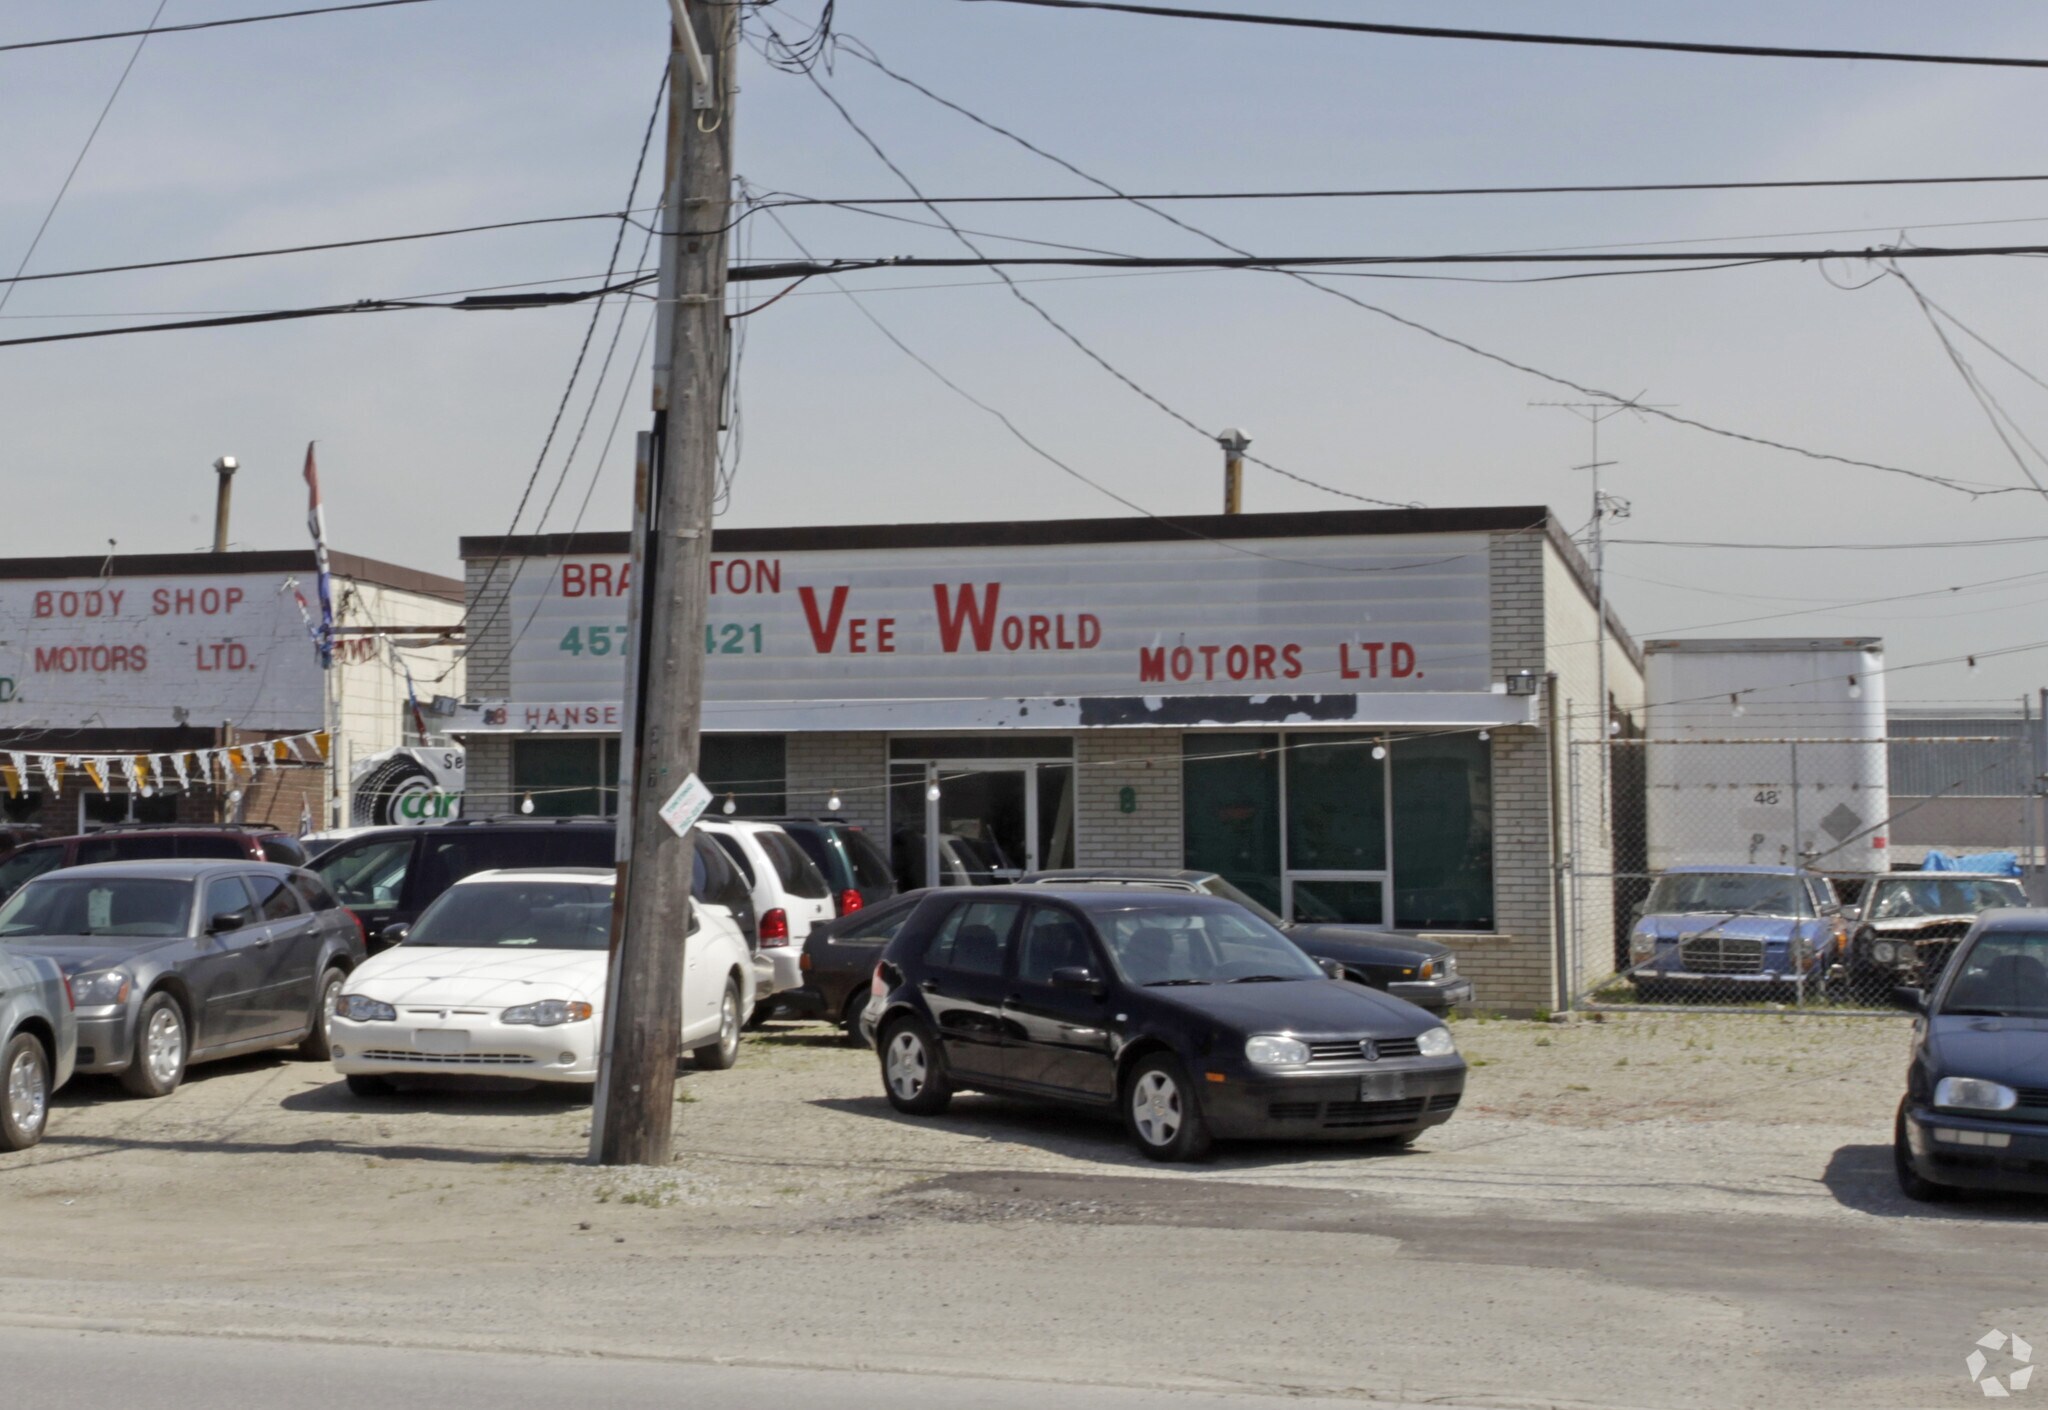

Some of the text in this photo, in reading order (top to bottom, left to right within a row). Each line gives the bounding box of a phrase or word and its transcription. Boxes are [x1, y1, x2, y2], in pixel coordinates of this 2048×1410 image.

[561, 559, 781, 598] BRATON
[35, 587, 244, 619] BODY SHOP
[559, 623, 763, 656] 457421
[34, 643, 257, 673] MOTORS LTD.
[1139, 641, 1424, 683] MOTORS LTD.
[401, 791, 458, 818] car
